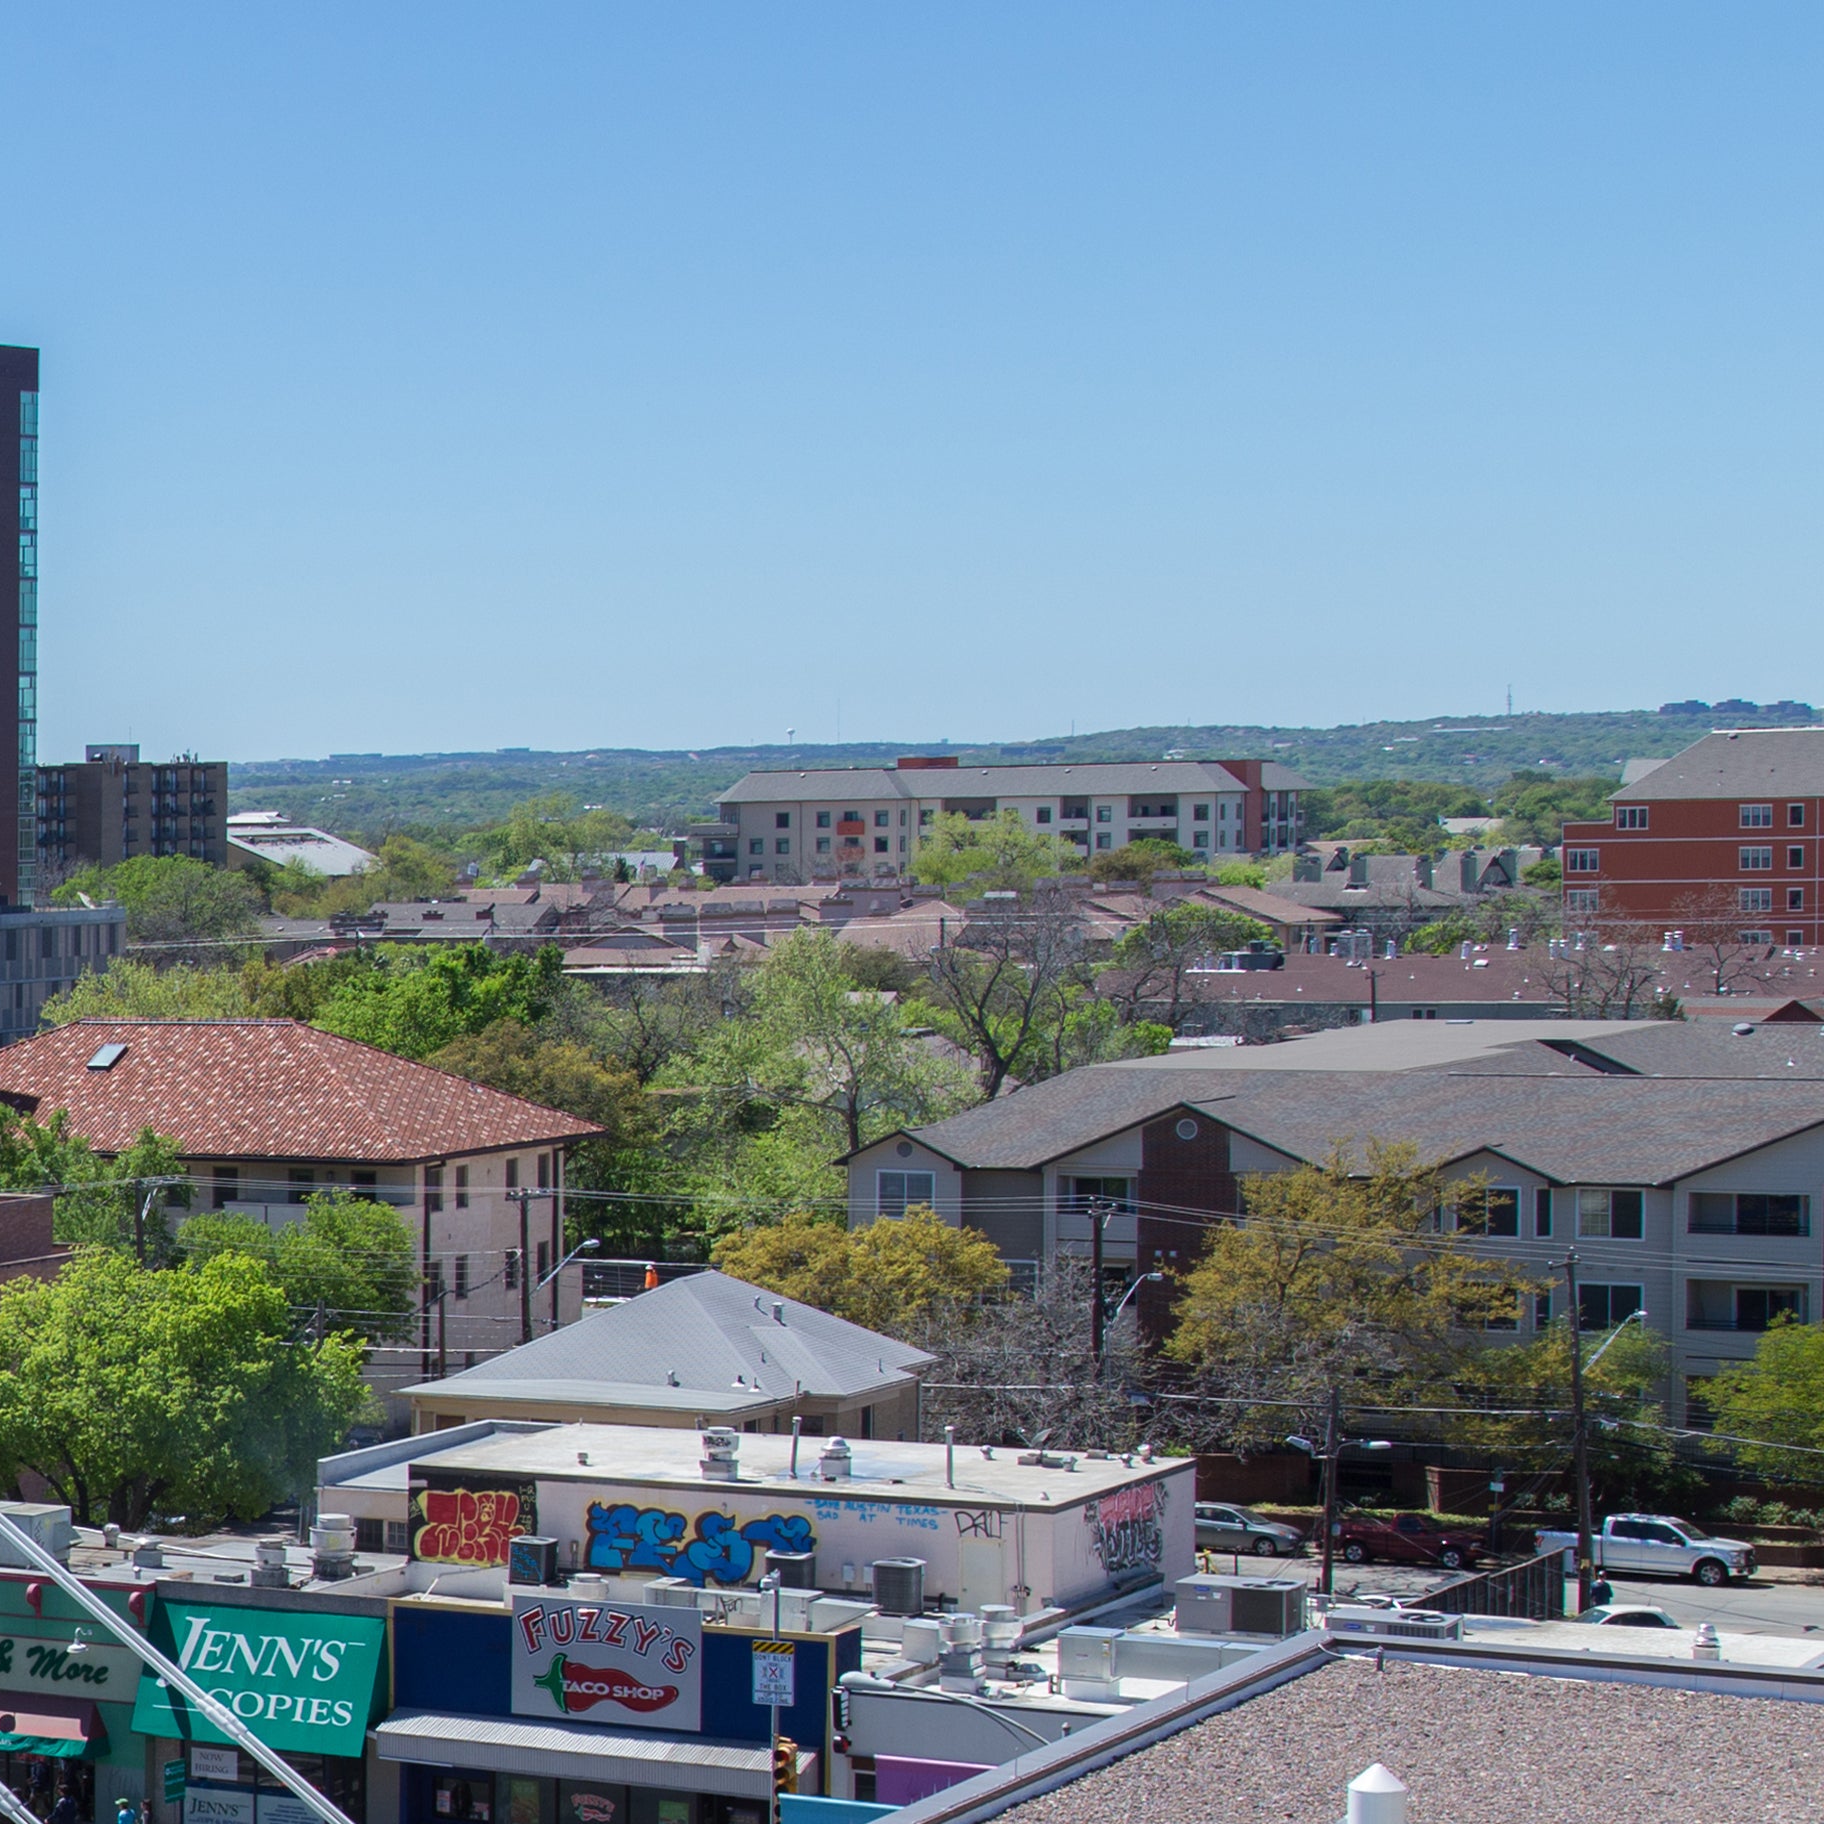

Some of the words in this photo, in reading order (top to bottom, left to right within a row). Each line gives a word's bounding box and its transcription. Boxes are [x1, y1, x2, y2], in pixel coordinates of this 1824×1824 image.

[844, 1501, 891, 1513] AUSTIN
[817, 1511, 839, 1521] SAD
[859, 1513, 877, 1523] AT
[896, 1517, 939, 1530] TIMES
[518, 1605, 696, 1674] FUZZY'S
[156, 1616, 346, 1688] JENN'S
[26, 1644, 110, 1684] More
[561, 1679, 610, 1696] TACO
[613, 1684, 665, 1701] SHOP
[207, 1687, 353, 1727] COPIES
[200, 1752, 224, 1762] NOW
[194, 1763, 229, 1775] HIRING
[190, 1797, 239, 1817] JENN'S
